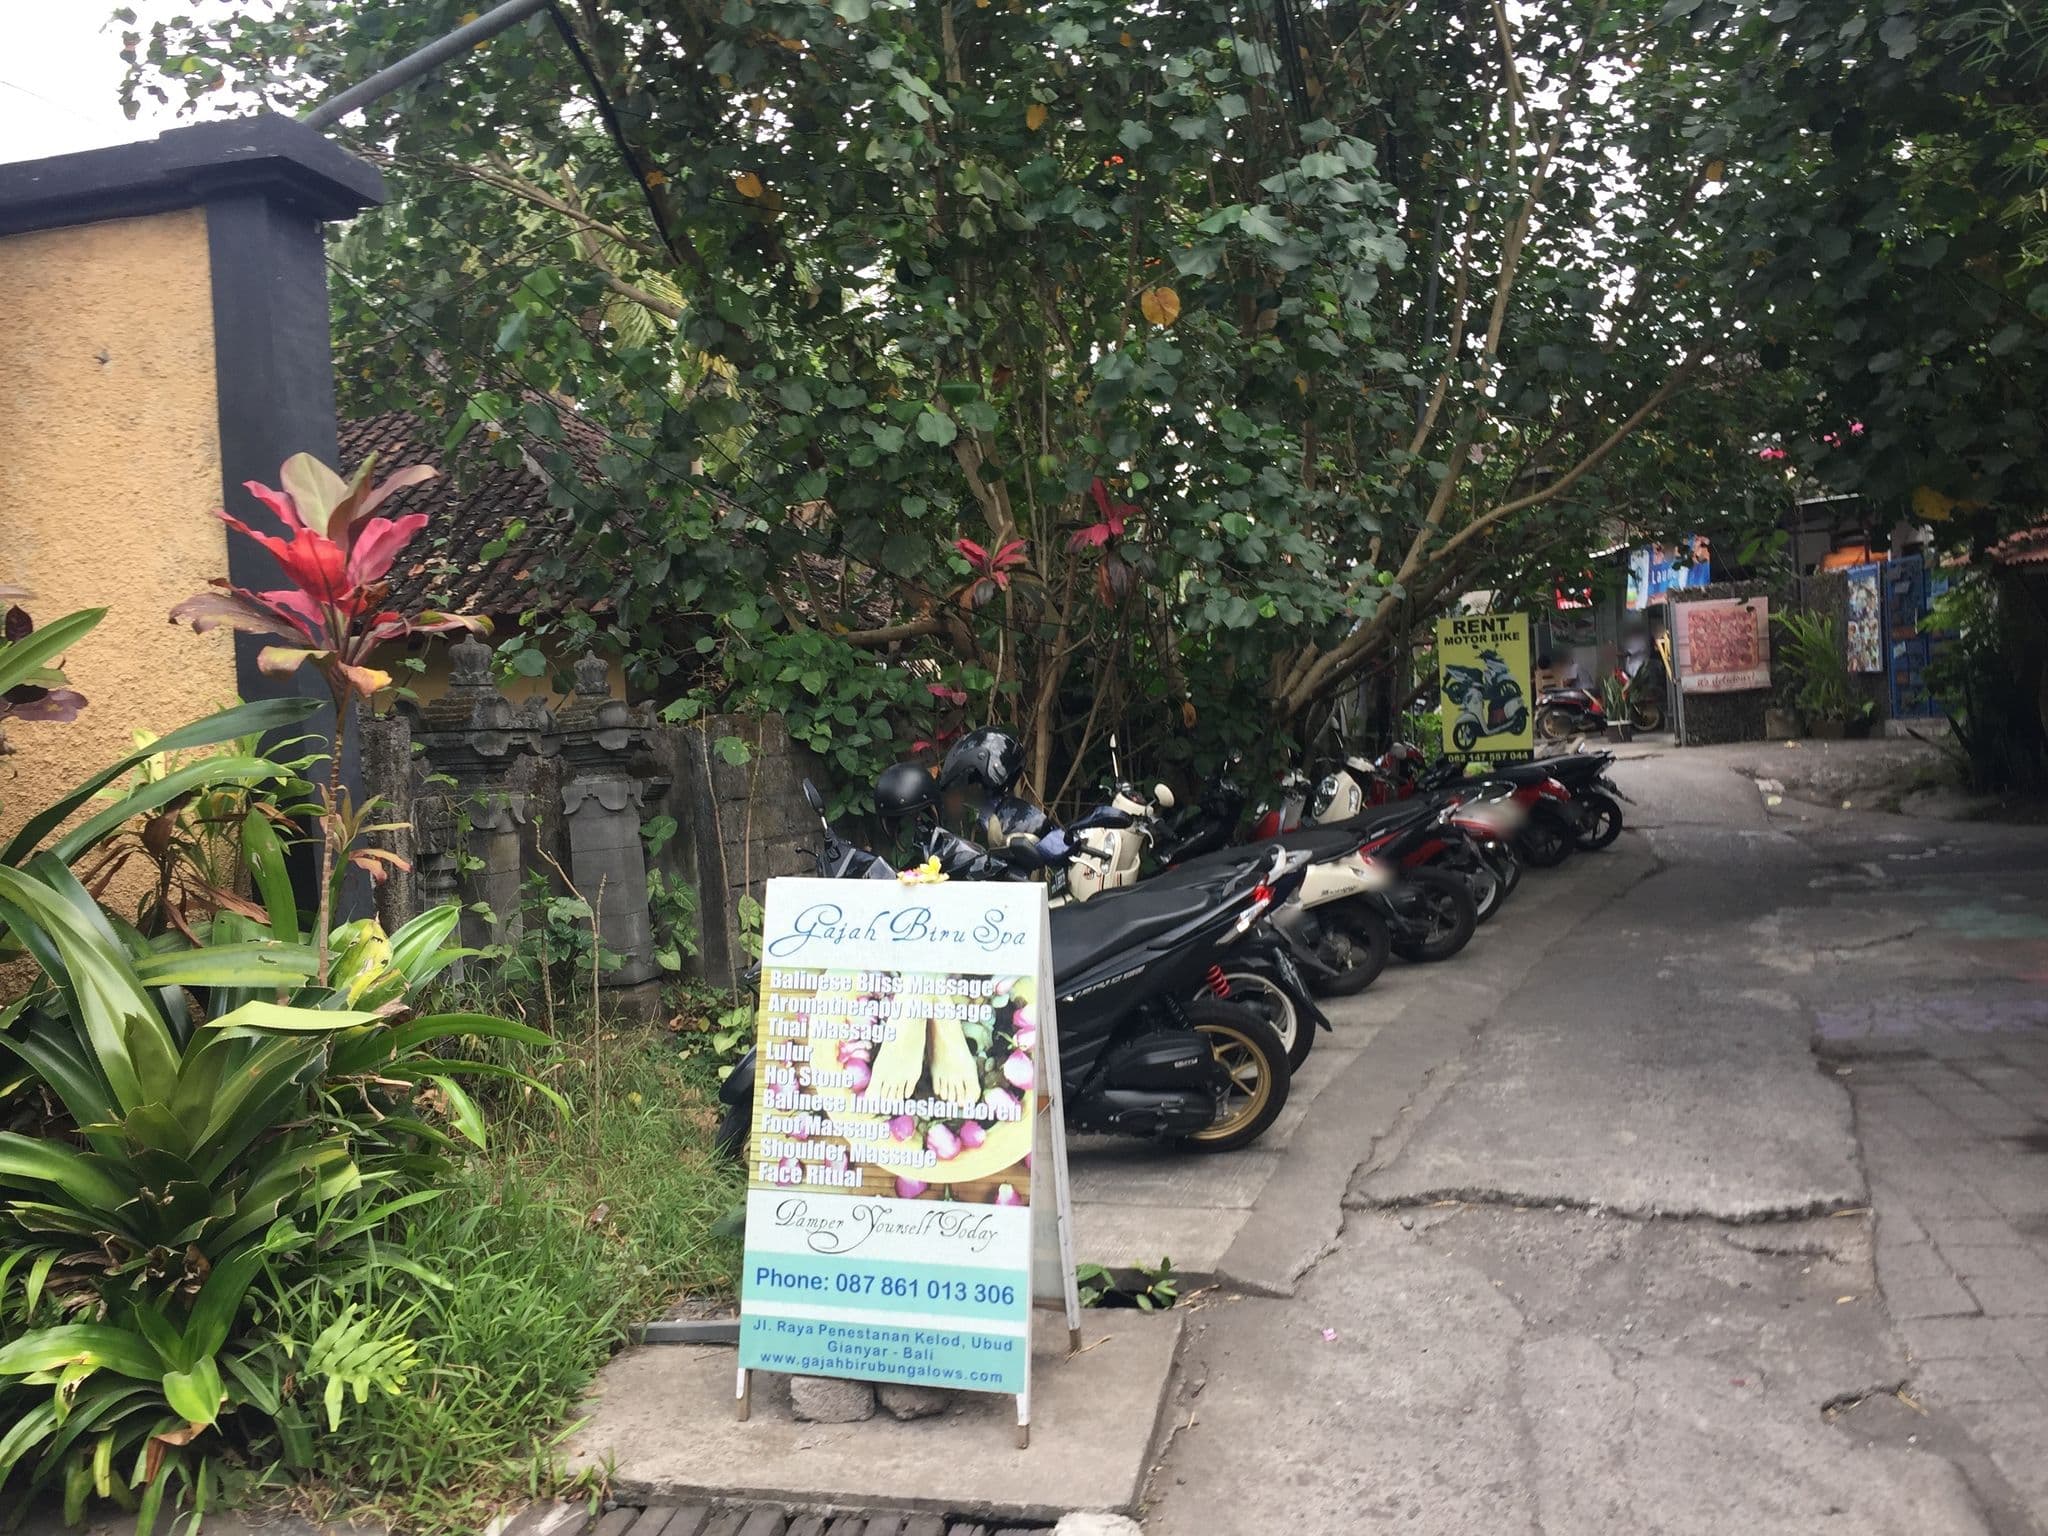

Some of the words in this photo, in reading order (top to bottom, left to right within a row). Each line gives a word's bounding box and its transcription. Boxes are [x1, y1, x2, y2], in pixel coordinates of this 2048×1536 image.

[1444, 634, 1487, 646] MOTOR
[1491, 632, 1520, 642] BIKE
[1453, 617, 1509, 635] RENT
[768, 904, 889, 957] Gajah
[889, 907, 966, 943] Biru
[973, 909, 1026, 952] Spa
[770, 970, 853, 992] Balinese
[856, 972, 904, 994] Bliss
[908, 975, 994, 998] Massage
[768, 994, 900, 1021] Aromatherapy
[905, 999, 993, 1022] Massage
[768, 1017, 808, 1038] Thai
[811, 1020, 897, 1043] Massage
[766, 1041, 813, 1062] Lulur
[765, 1065, 797, 1086] Hot
[799, 1067, 855, 1088] Stone
[763, 1089, 846, 1113] Balinese
[851, 1095, 960, 1119] Indonesian
[761, 1113, 803, 1135] Foot
[805, 1116, 890, 1140] Massage
[760, 1137, 848, 1160] Shoulder
[851, 1143, 937, 1167] Massage
[758, 1162, 803, 1184] Face
[806, 1165, 863, 1187] Ritual
[775, 1198, 844, 1233] Pamper
[807, 1204, 938, 1254] Yourself
[938, 1209, 998, 1252] Today
[756, 1267, 829, 1291] Phone:
[836, 1273, 875, 1294] 087
[881, 1277, 918, 1298] 861
[927, 1280, 967, 1301] 013
[974, 1284, 1014, 1305] 306
[753, 1320, 771, 1332] Jl.
[777, 1321, 813, 1337] Raya
[819, 1324, 910, 1344] Penestanan
[915, 1332, 966, 1350] Kelod,
[971, 1336, 1013, 1352] Ubud
[827, 1341, 888, 1359] Gianyar
[904, 1347, 934, 1361] Bali
[760, 1352, 1003, 1383] www.gajahbirubungalows.com
